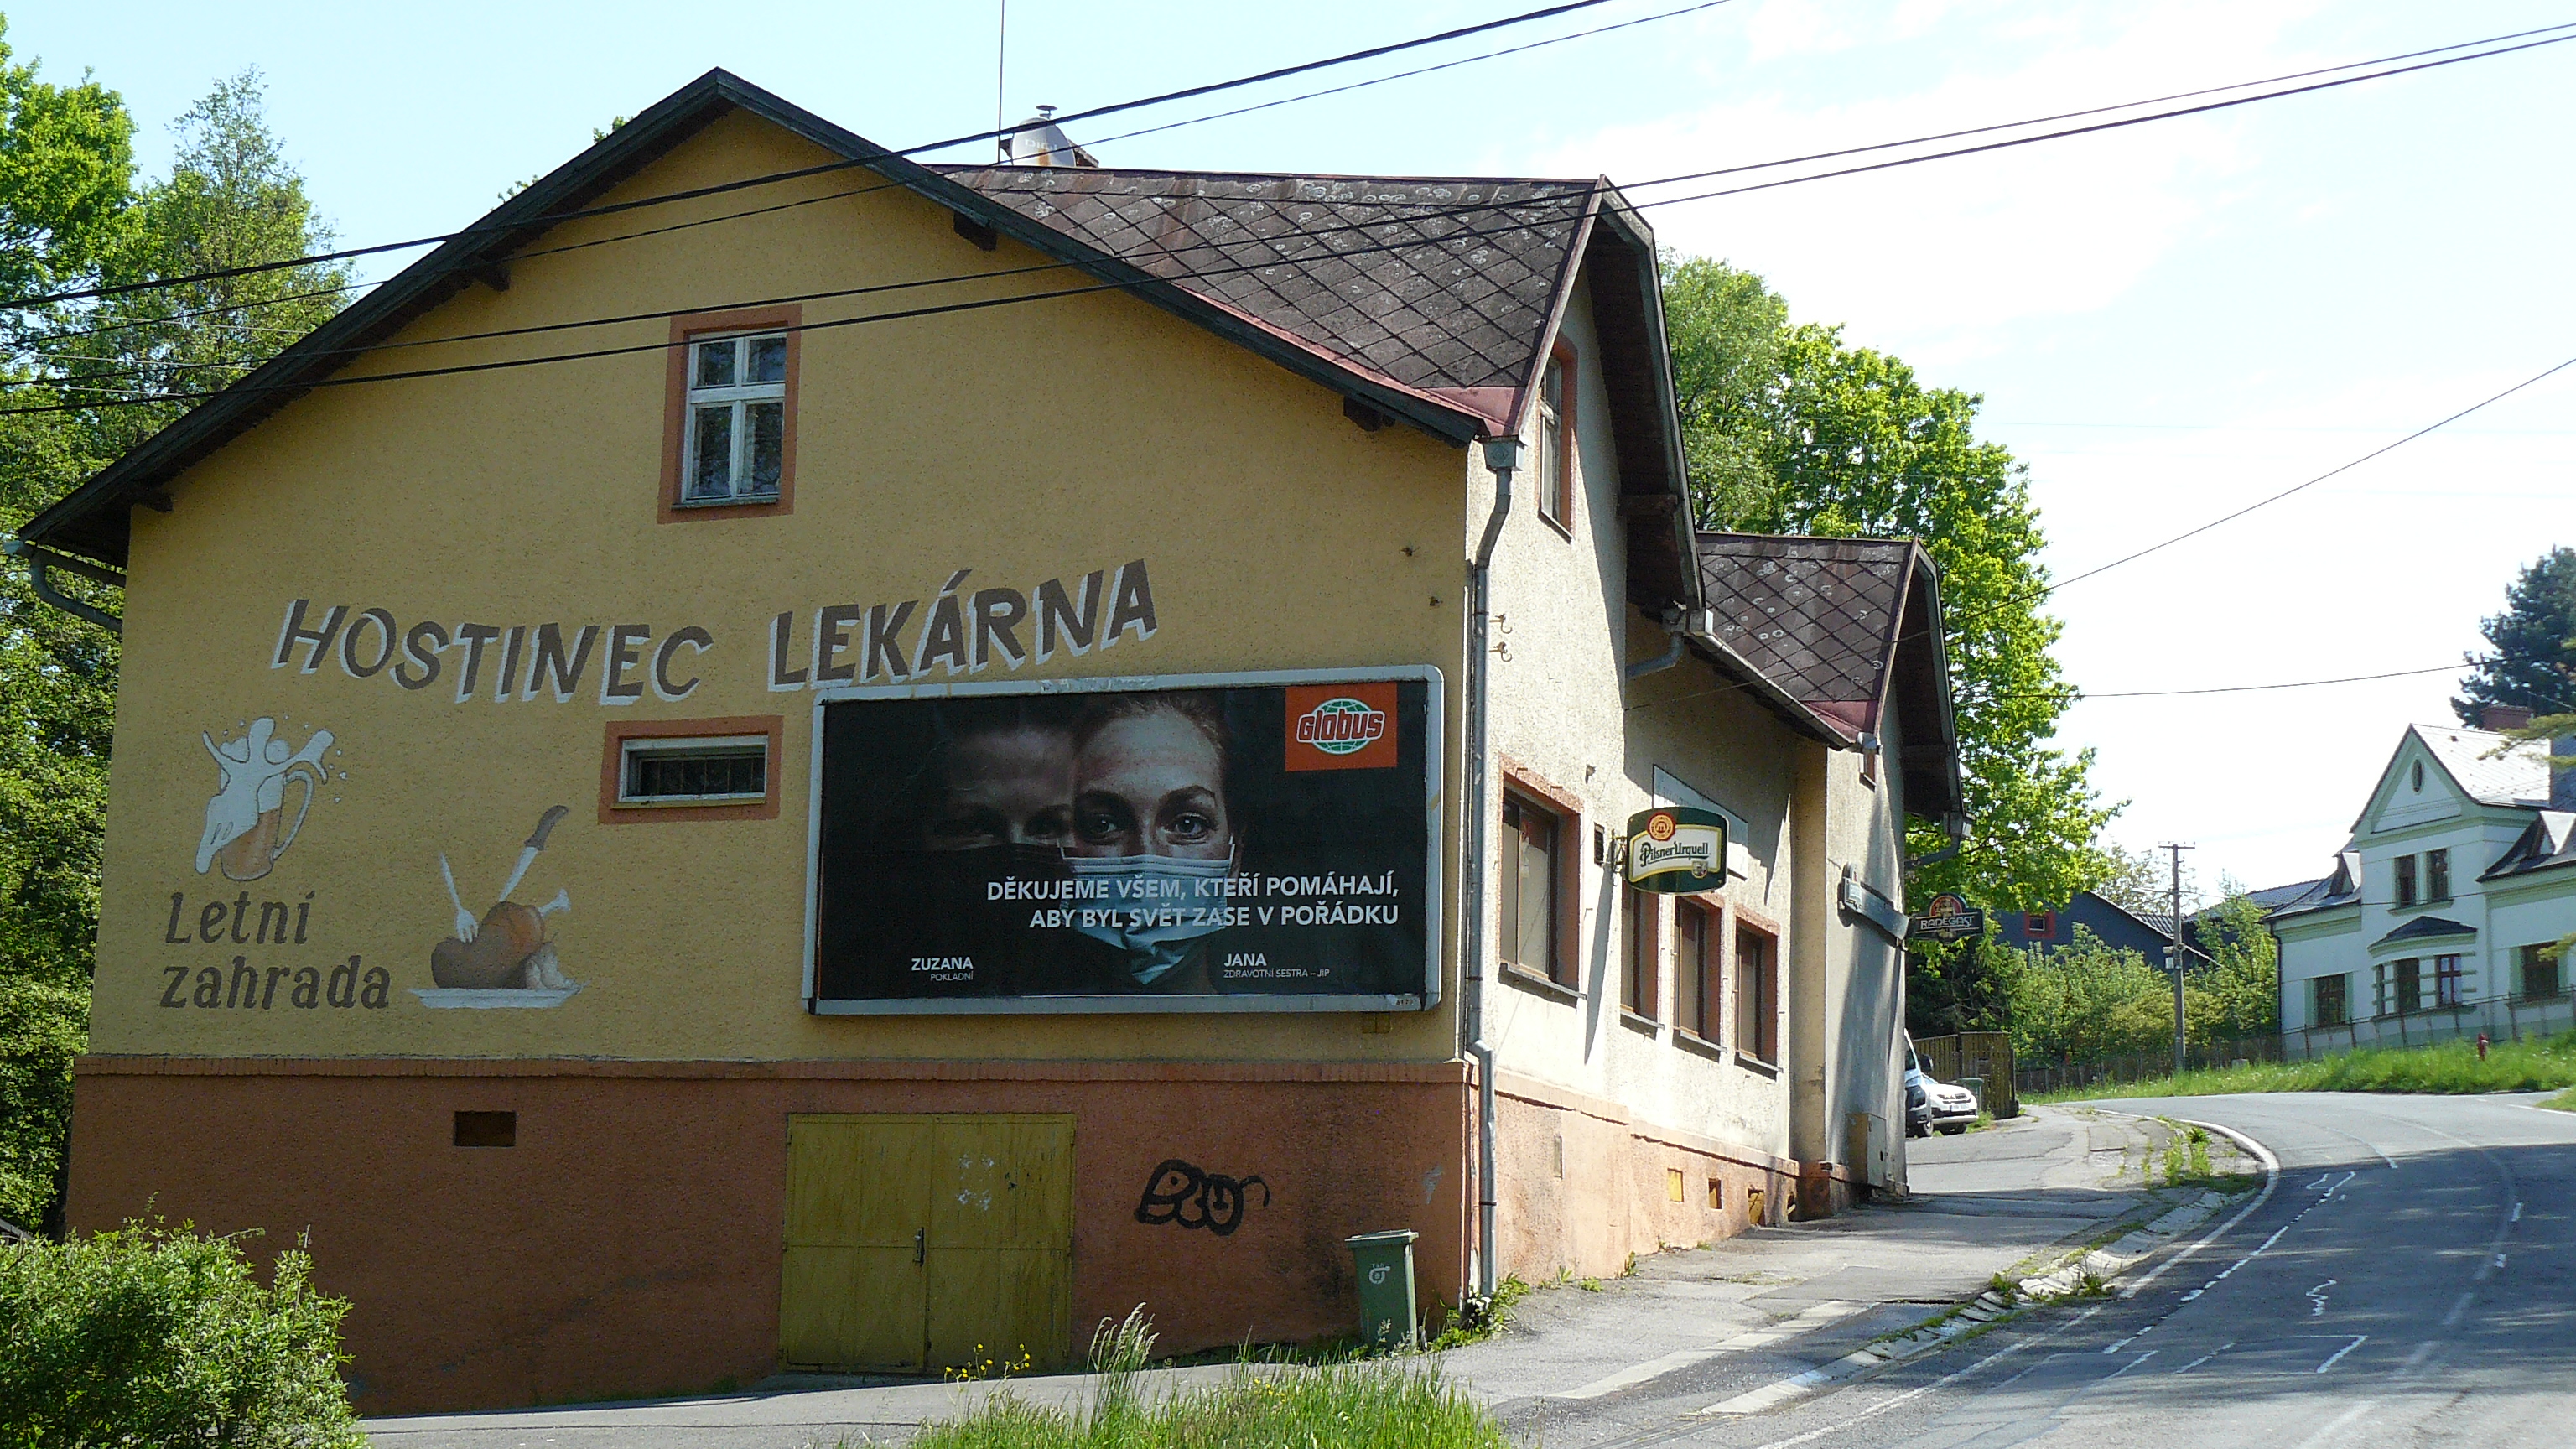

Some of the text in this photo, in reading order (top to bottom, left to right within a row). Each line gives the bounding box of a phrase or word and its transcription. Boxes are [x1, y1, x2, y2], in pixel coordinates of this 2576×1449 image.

[270, 558, 1158, 706] HOSTINEC LEKÁRNA
[1296, 707, 1385, 743] Globus
[1639, 840, 1709, 867] Pilsner Urquell
[987, 870, 1399, 901] DĚKUJEME VŠEM, KTEŘÍ POMÁHAJÍ,
[164, 890, 315, 945] Letní
[1029, 900, 1399, 928] ABY BYL SVĚT ZASE V POŘÁDKU
[1920, 915, 1975, 929] RADEGAST
[911, 956, 974, 971] ZUZANA
[1223, 953, 1267, 967] JANA
[1223, 968, 1274, 979] ZDRAVOTNÍ
[1275, 969, 1309, 978] SESTRA
[1317, 968, 1330, 977] JIP
[158, 954, 391, 1010] zahrada
[930, 971, 974, 981] POKLADNÍ
